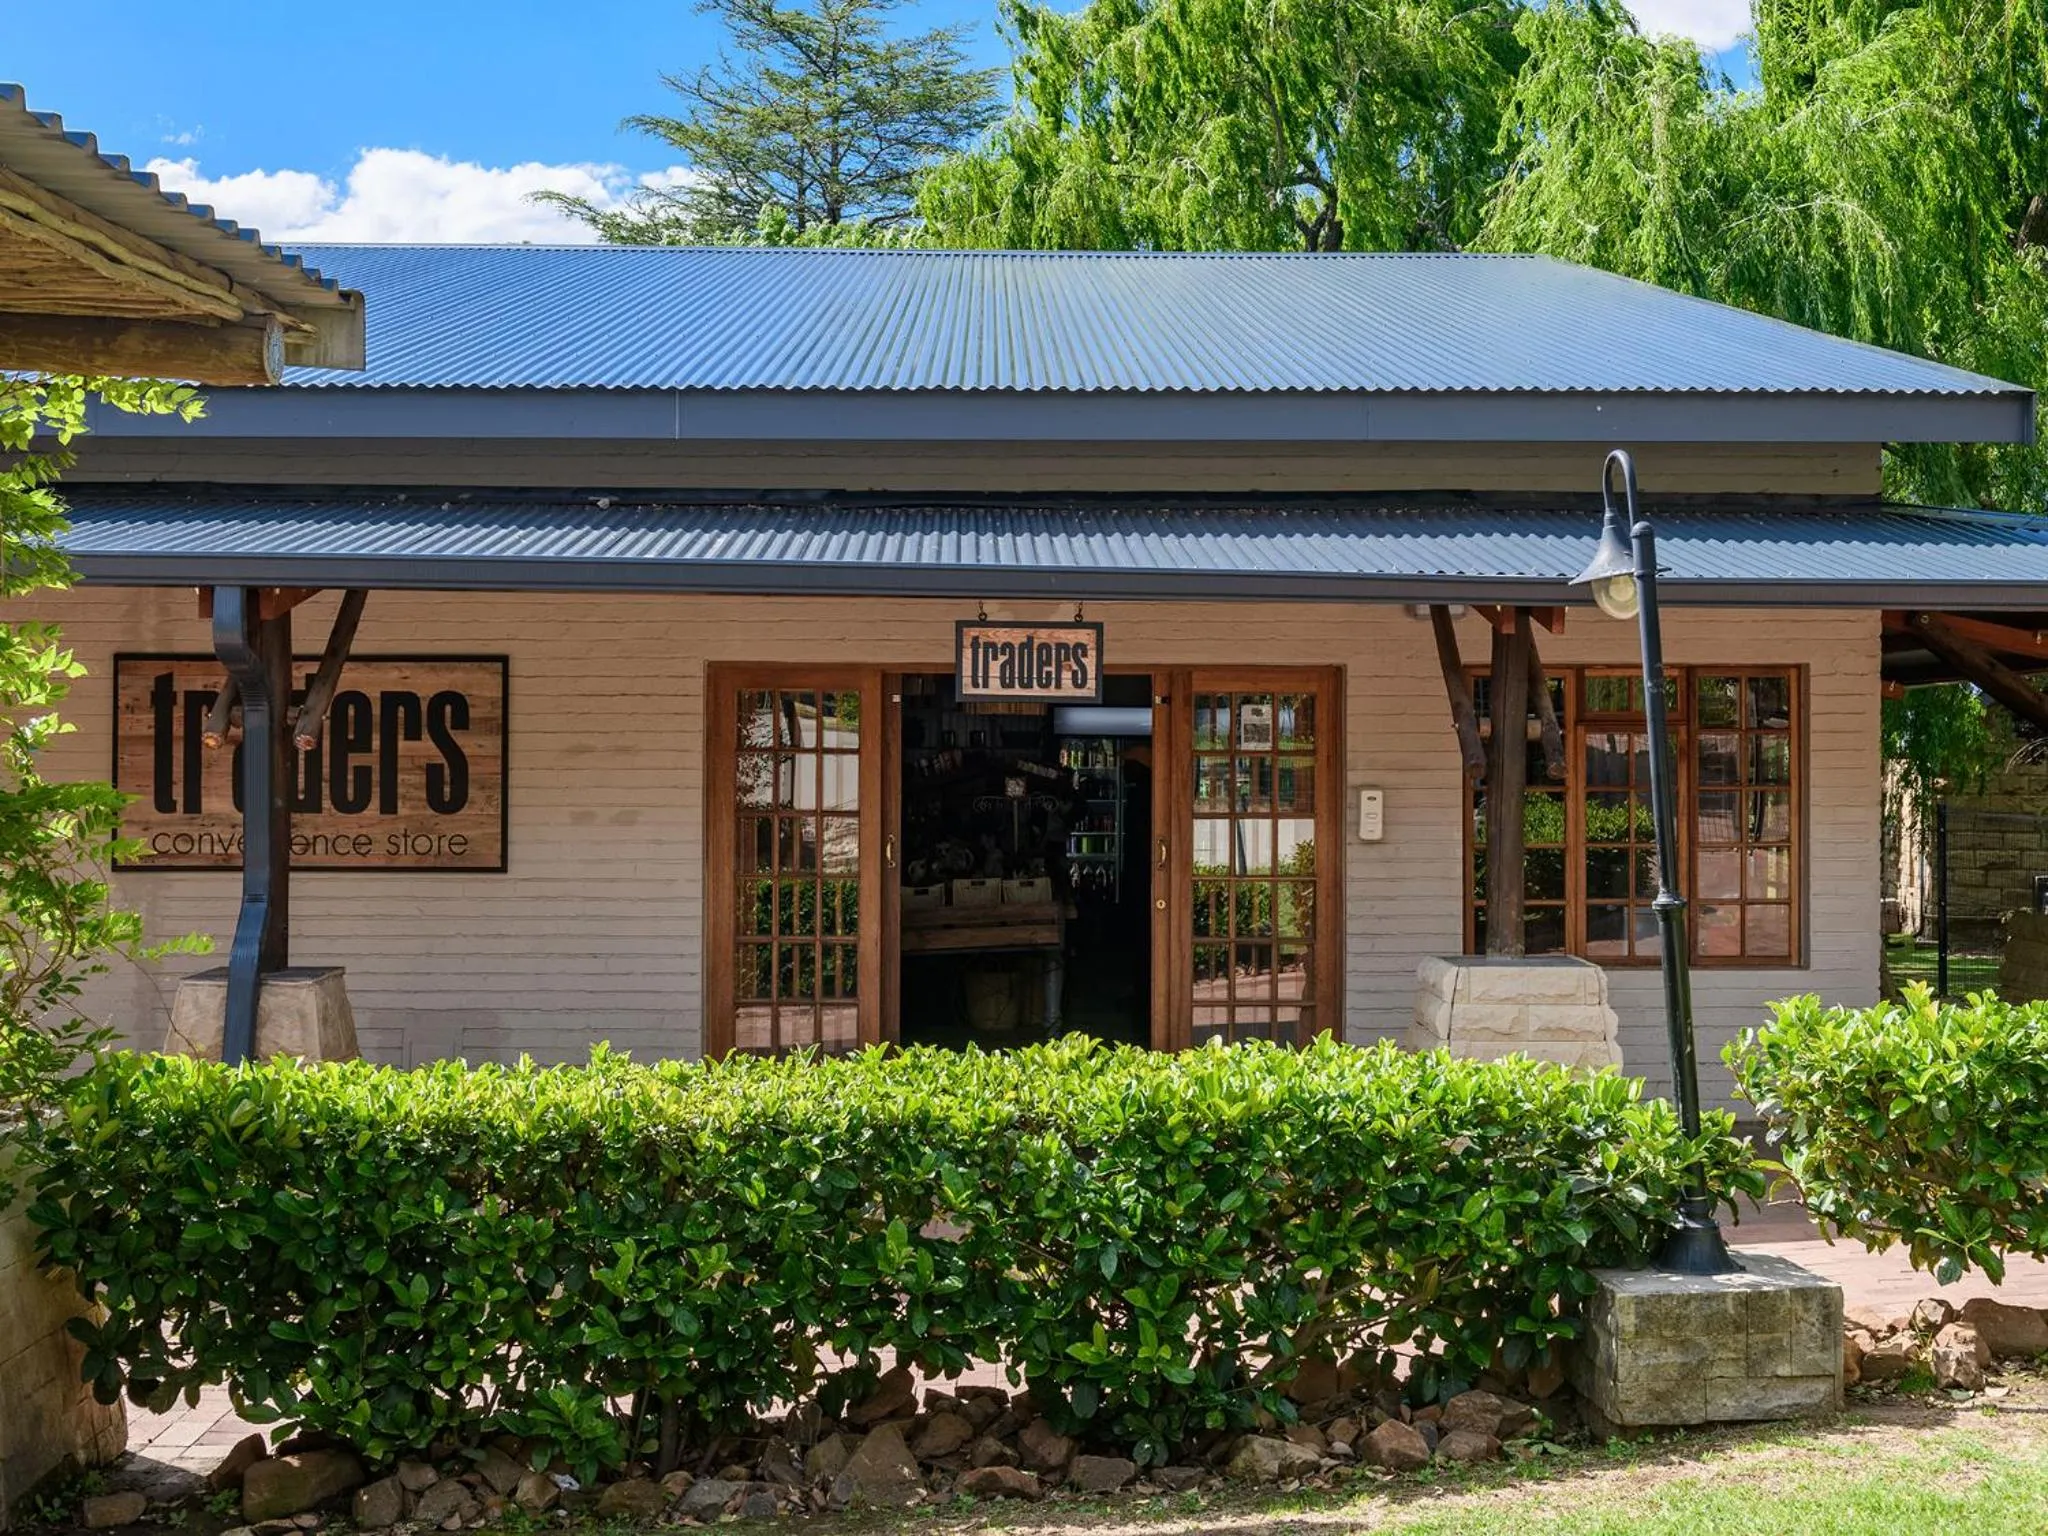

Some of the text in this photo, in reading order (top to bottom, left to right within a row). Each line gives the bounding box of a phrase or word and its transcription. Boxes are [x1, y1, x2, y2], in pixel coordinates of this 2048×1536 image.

[970, 635, 1088, 690] traders
[151, 672, 470, 815] trders
[152, 828, 469, 858] convence store
